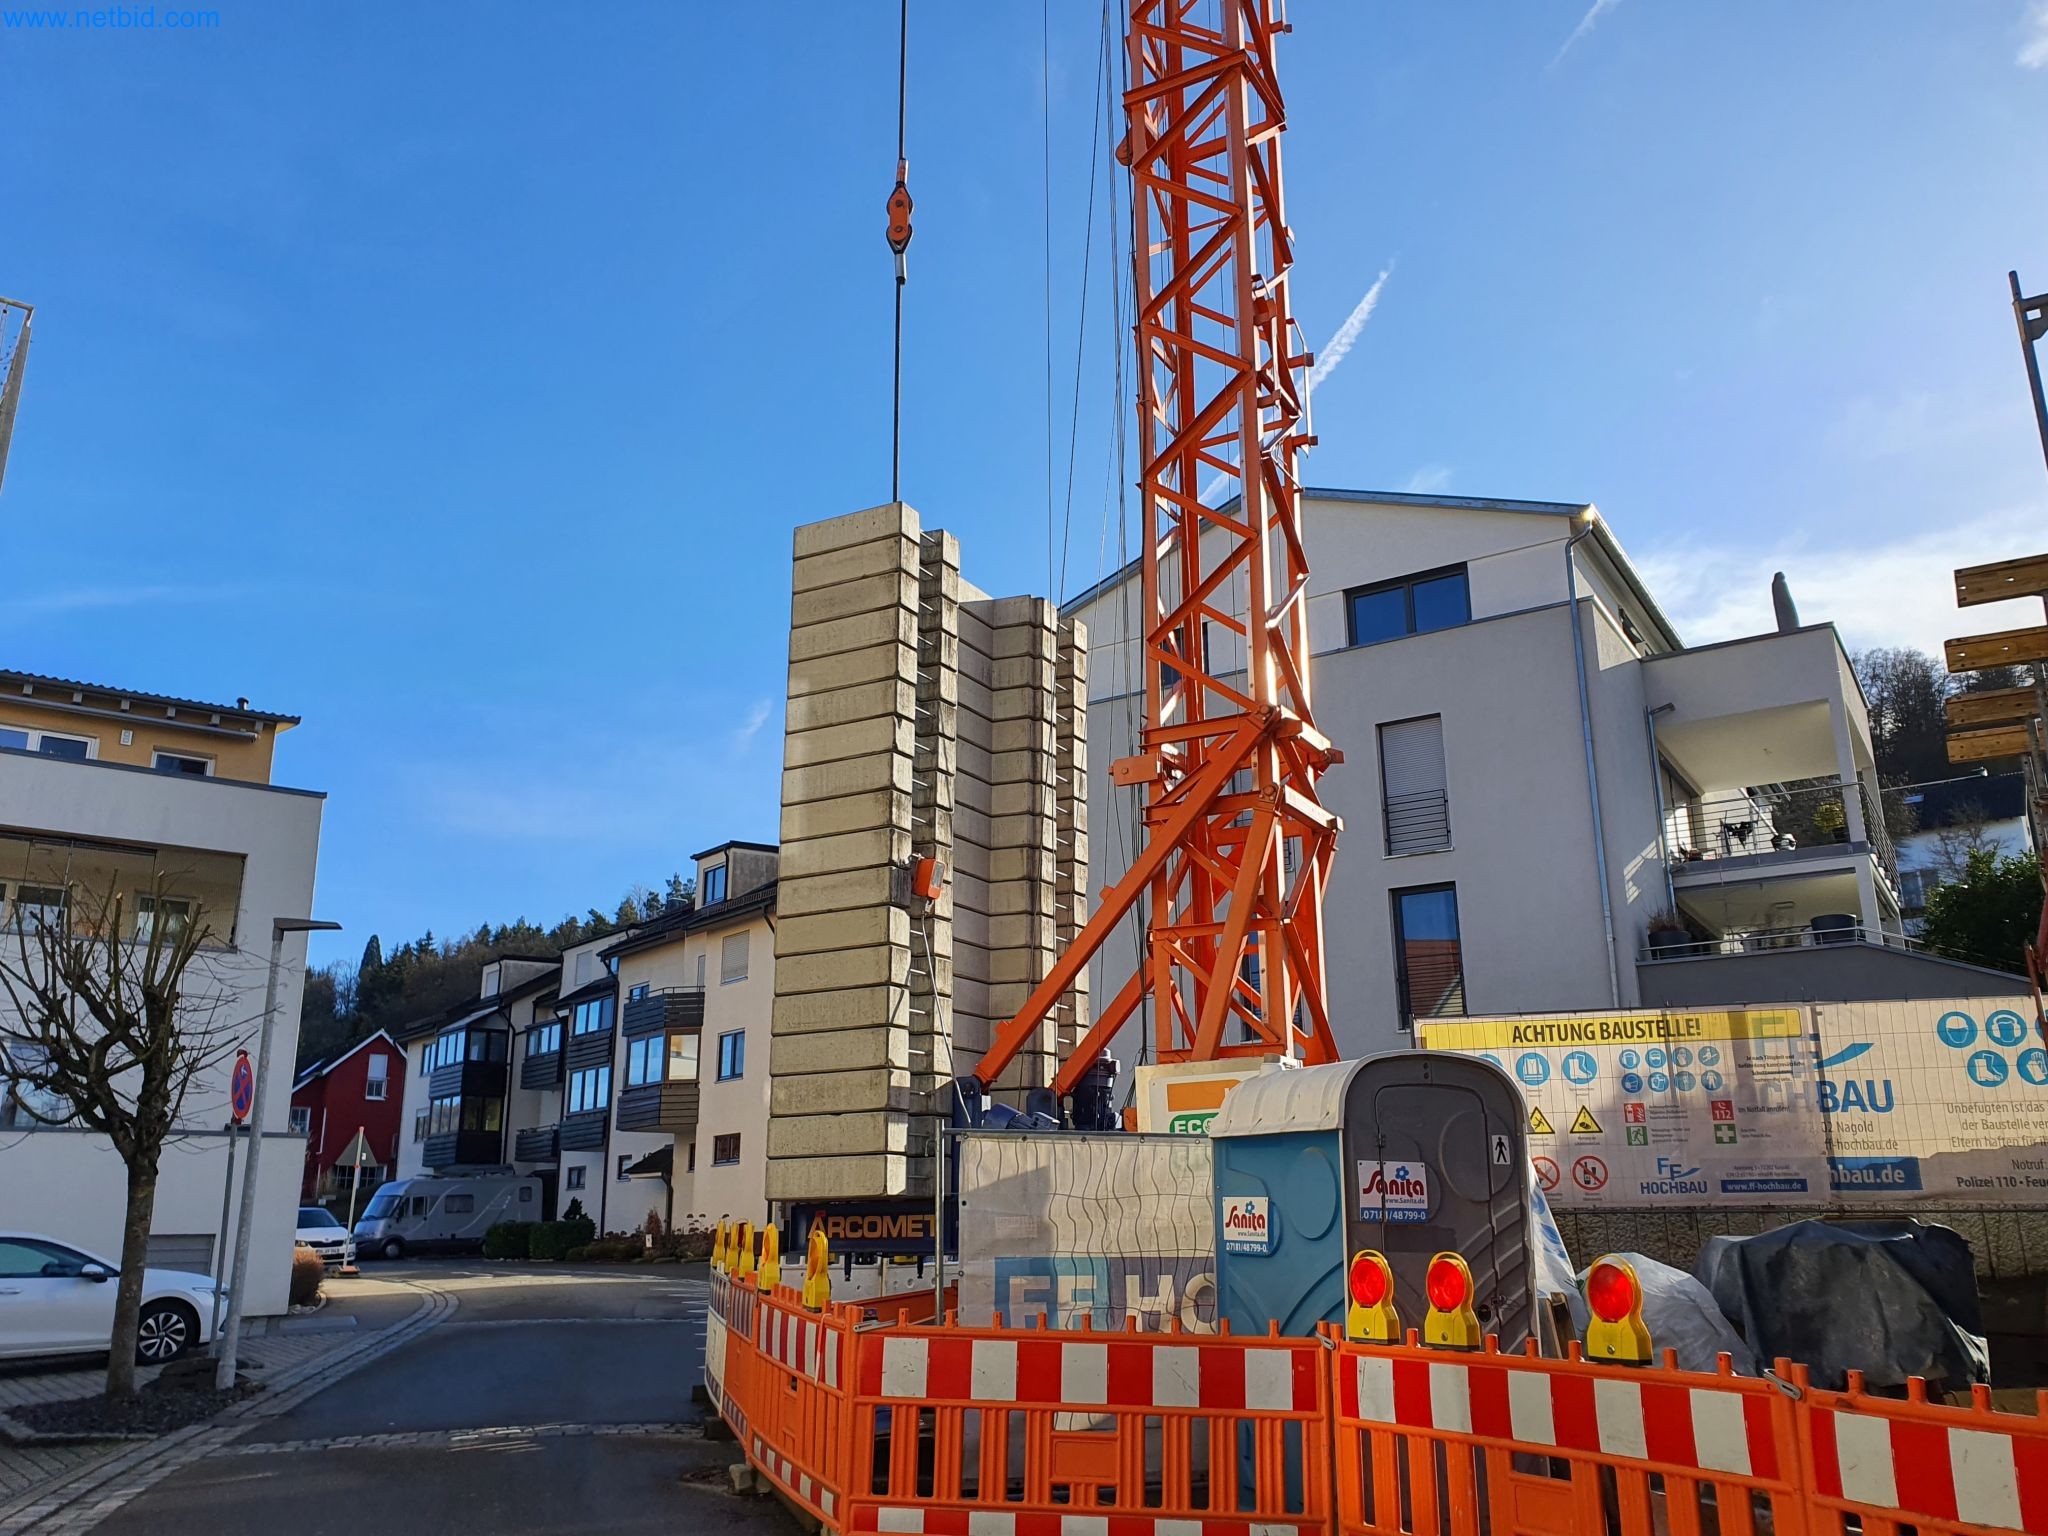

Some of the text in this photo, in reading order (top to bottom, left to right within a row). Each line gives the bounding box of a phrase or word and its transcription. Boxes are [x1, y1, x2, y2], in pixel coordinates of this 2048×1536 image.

[1512, 1017, 1702, 1043] ACHTUNG BAUSTELLE!
[1714, 1110, 1732, 1120] 112
[1947, 1100, 2045, 1116] Unbefugten ist das
[1836, 1121, 1874, 1136] Nagold
[1962, 1119, 1978, 1131] der
[1981, 1118, 2031, 1130] Baustelle
[1951, 1137, 1982, 1148] Eltern
[1984, 1136, 2020, 1148] haften
[1362, 1169, 1425, 1198] Sanita
[1640, 1180, 1708, 1195] HOCHBAU
[1727, 1181, 1802, 1191] www.ff-hochbau.de
[1956, 1175, 2048, 1188] Polizei 110 Feu
[1225, 1205, 1266, 1231] Sanita
[808, 1213, 936, 1239] ARCOMET
